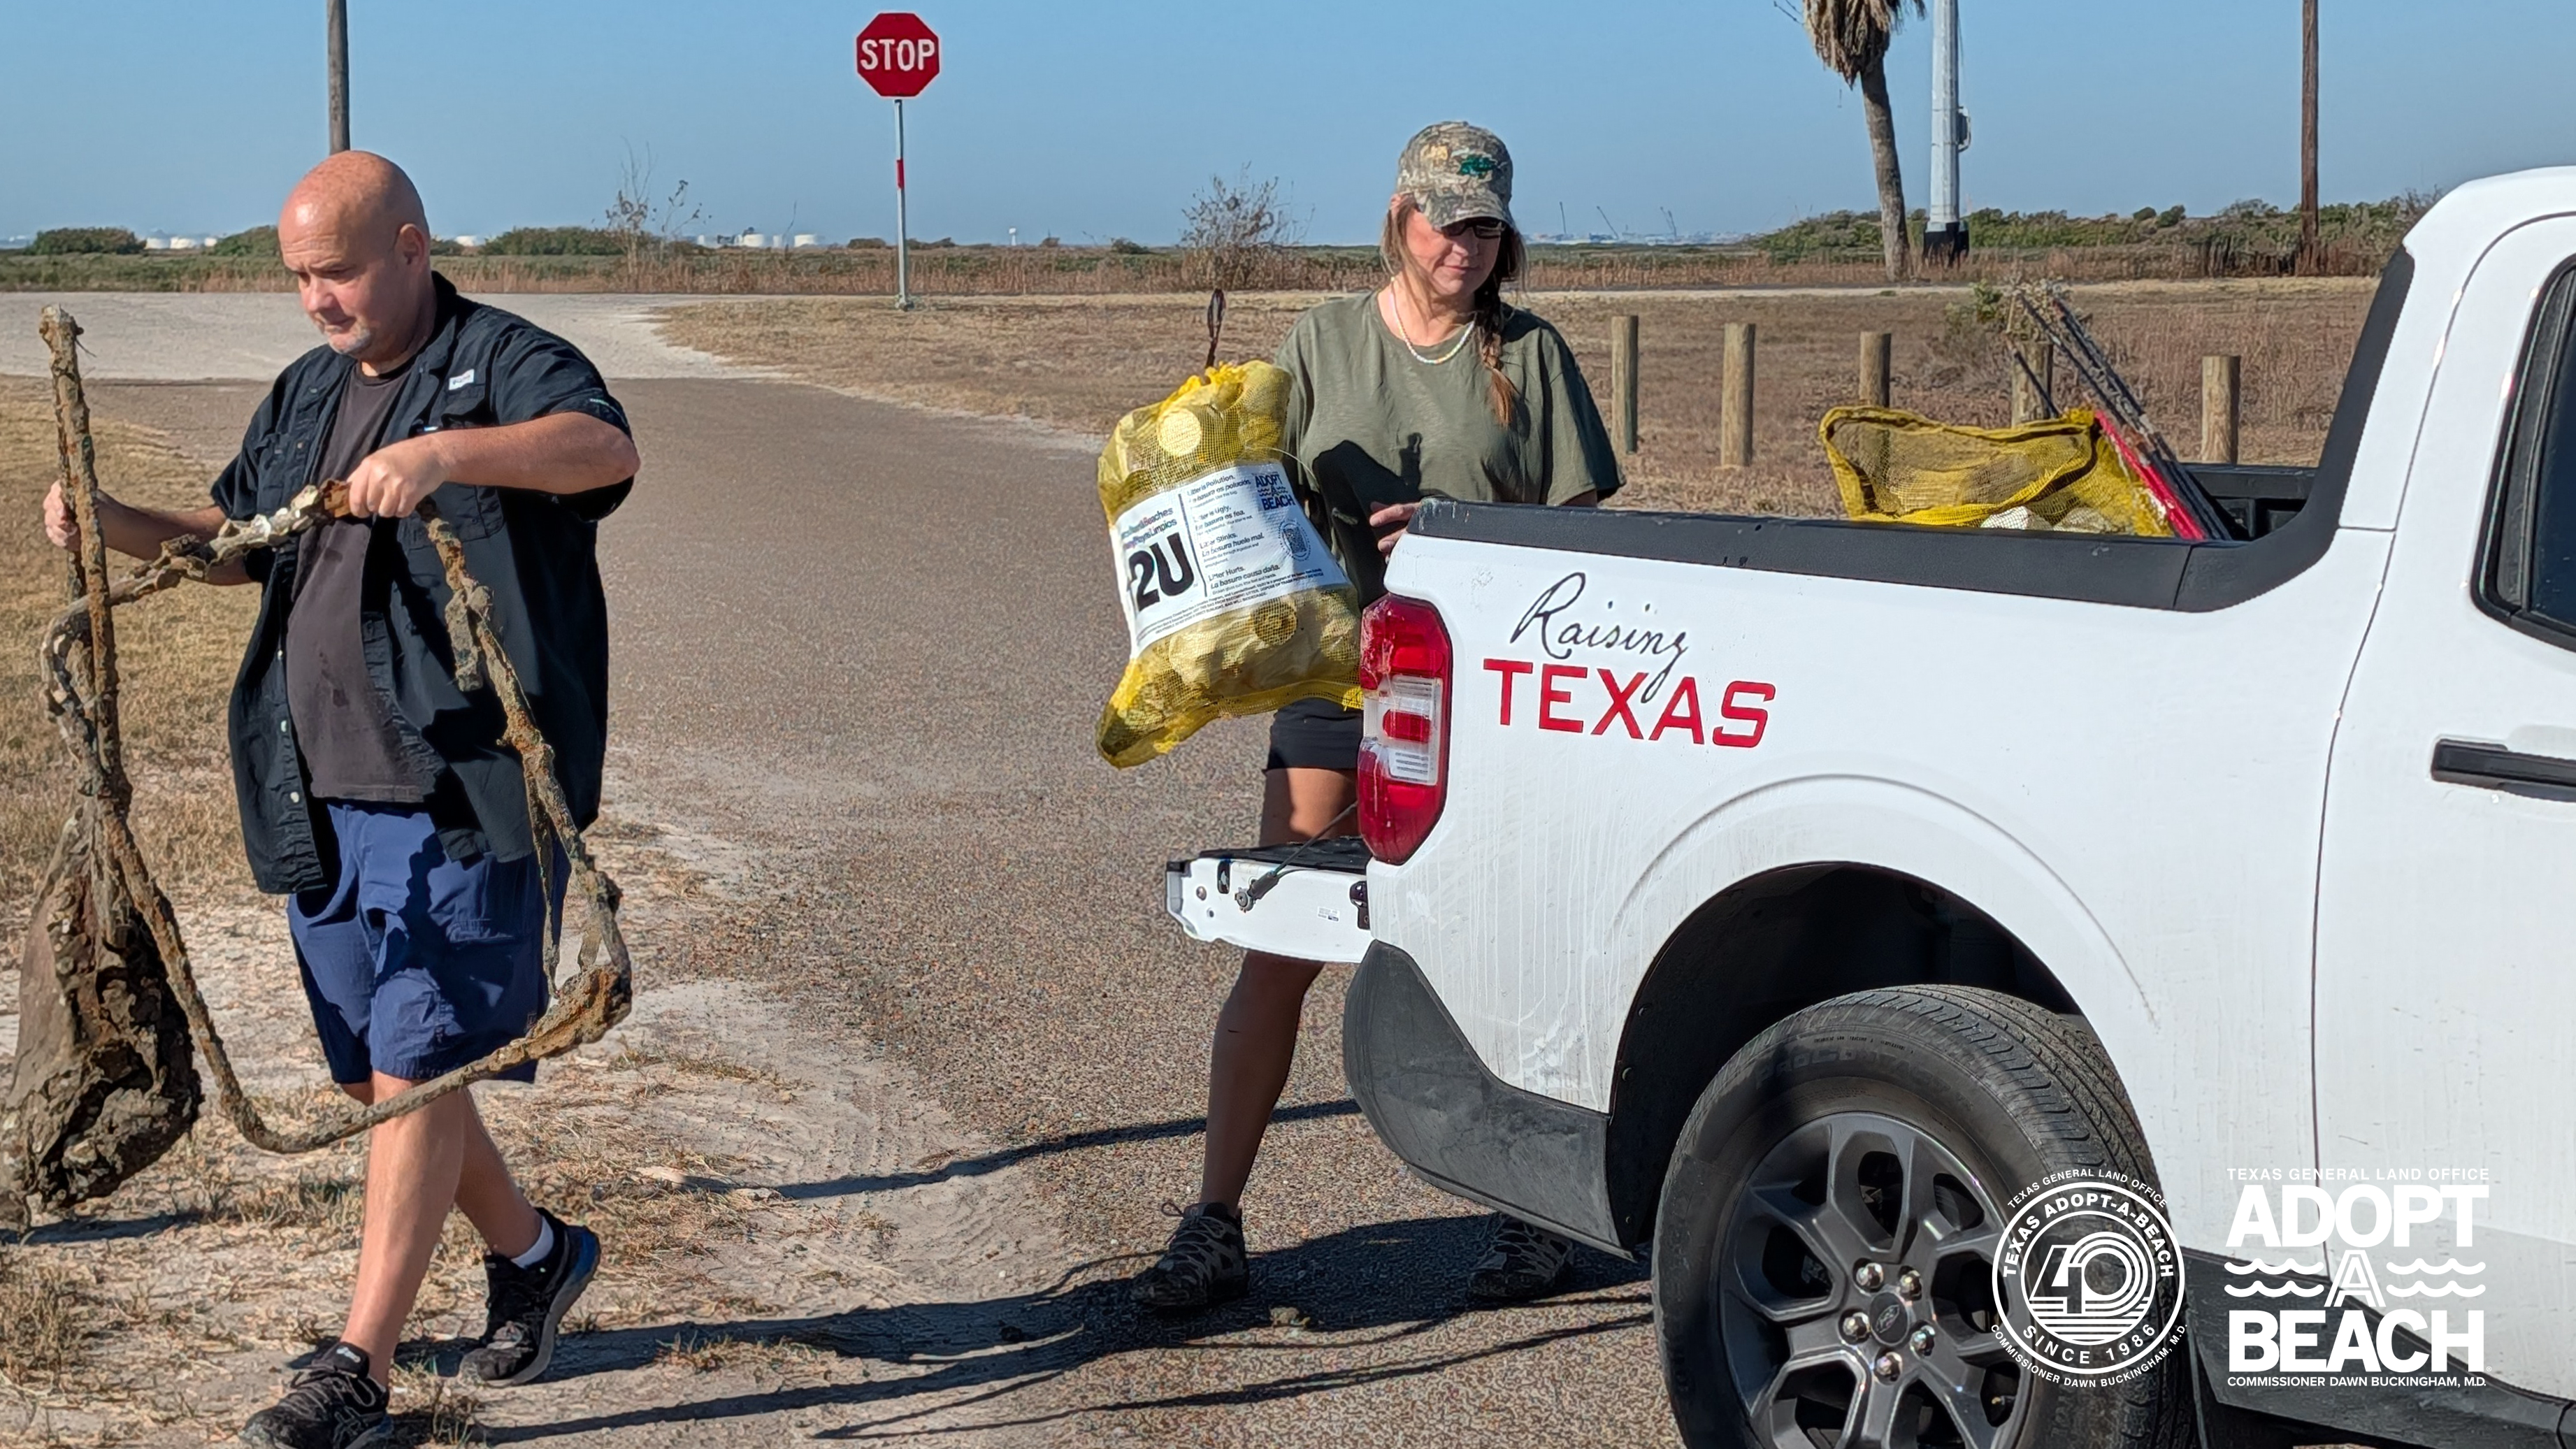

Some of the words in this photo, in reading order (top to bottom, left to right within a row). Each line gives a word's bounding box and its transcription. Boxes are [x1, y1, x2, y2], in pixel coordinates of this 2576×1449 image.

[861, 38, 935, 71] STOP
[1206, 475, 1235, 488] Pollution.
[1255, 474, 1283, 487] ADOPT
[1197, 489, 1215, 500] basura
[1261, 495, 1295, 510] BEACH
[1193, 513, 1209, 523] Lter
[1215, 505, 1231, 514] Ugly.
[1204, 516, 1223, 527] basura
[1211, 542, 1232, 554] basura
[1232, 537, 1251, 547] huele
[1251, 533, 1265, 541] mal.
[1216, 533, 1238, 543] Stinks.
[1128, 533, 1194, 611] 2U
[1219, 575, 1242, 586] basura
[1243, 570, 1262, 579] causa
[1225, 566, 1246, 575] Hurts.
[1510, 572, 1690, 703] Raising
[1483, 658, 1776, 749] TEXAS
